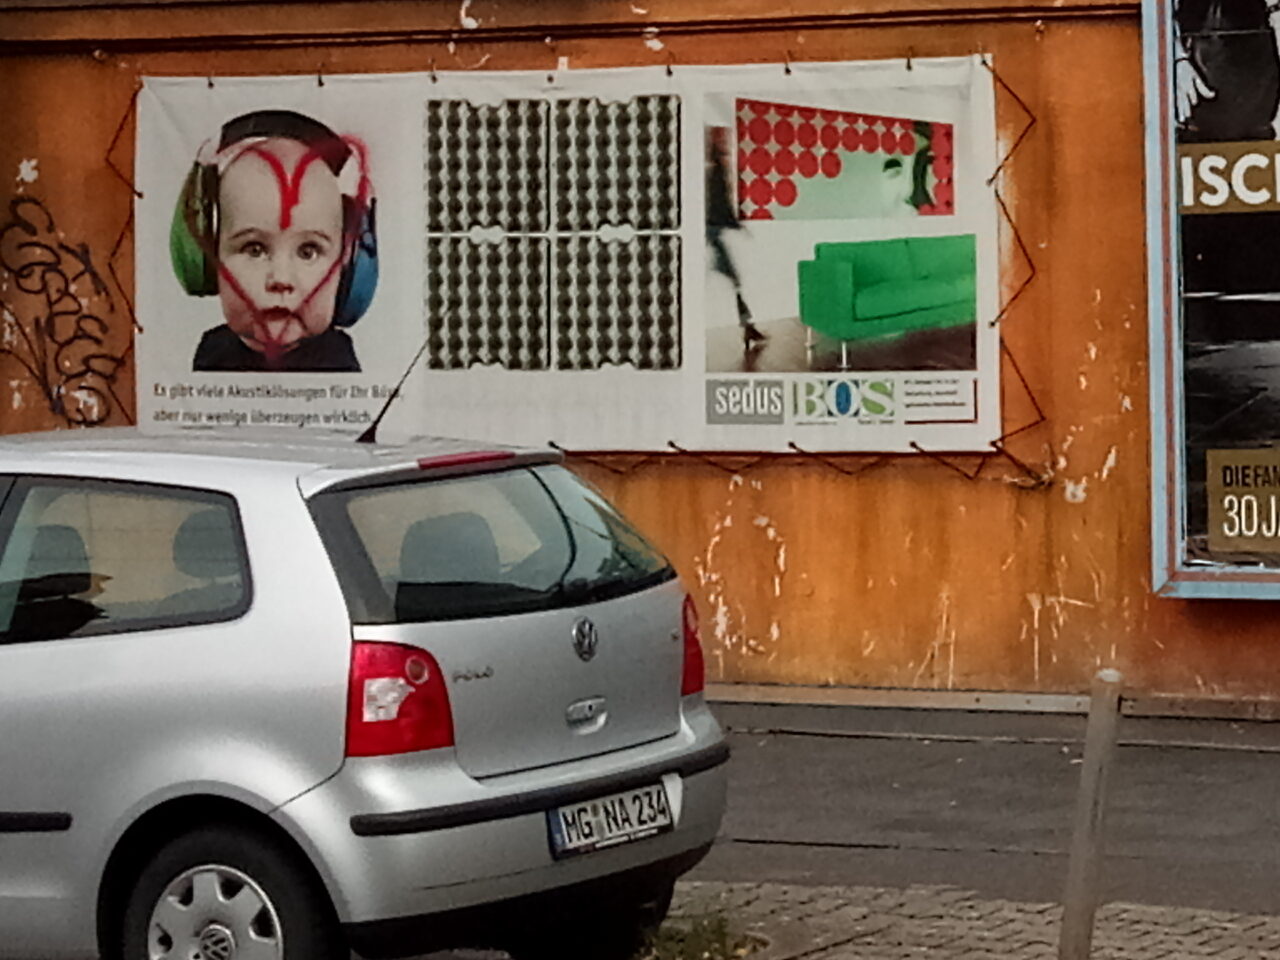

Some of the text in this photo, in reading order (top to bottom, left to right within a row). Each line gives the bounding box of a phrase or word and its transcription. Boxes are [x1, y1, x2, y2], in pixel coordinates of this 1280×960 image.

[715, 381, 782, 415] sedus
[562, 789, 667, 843] MG NA 234
